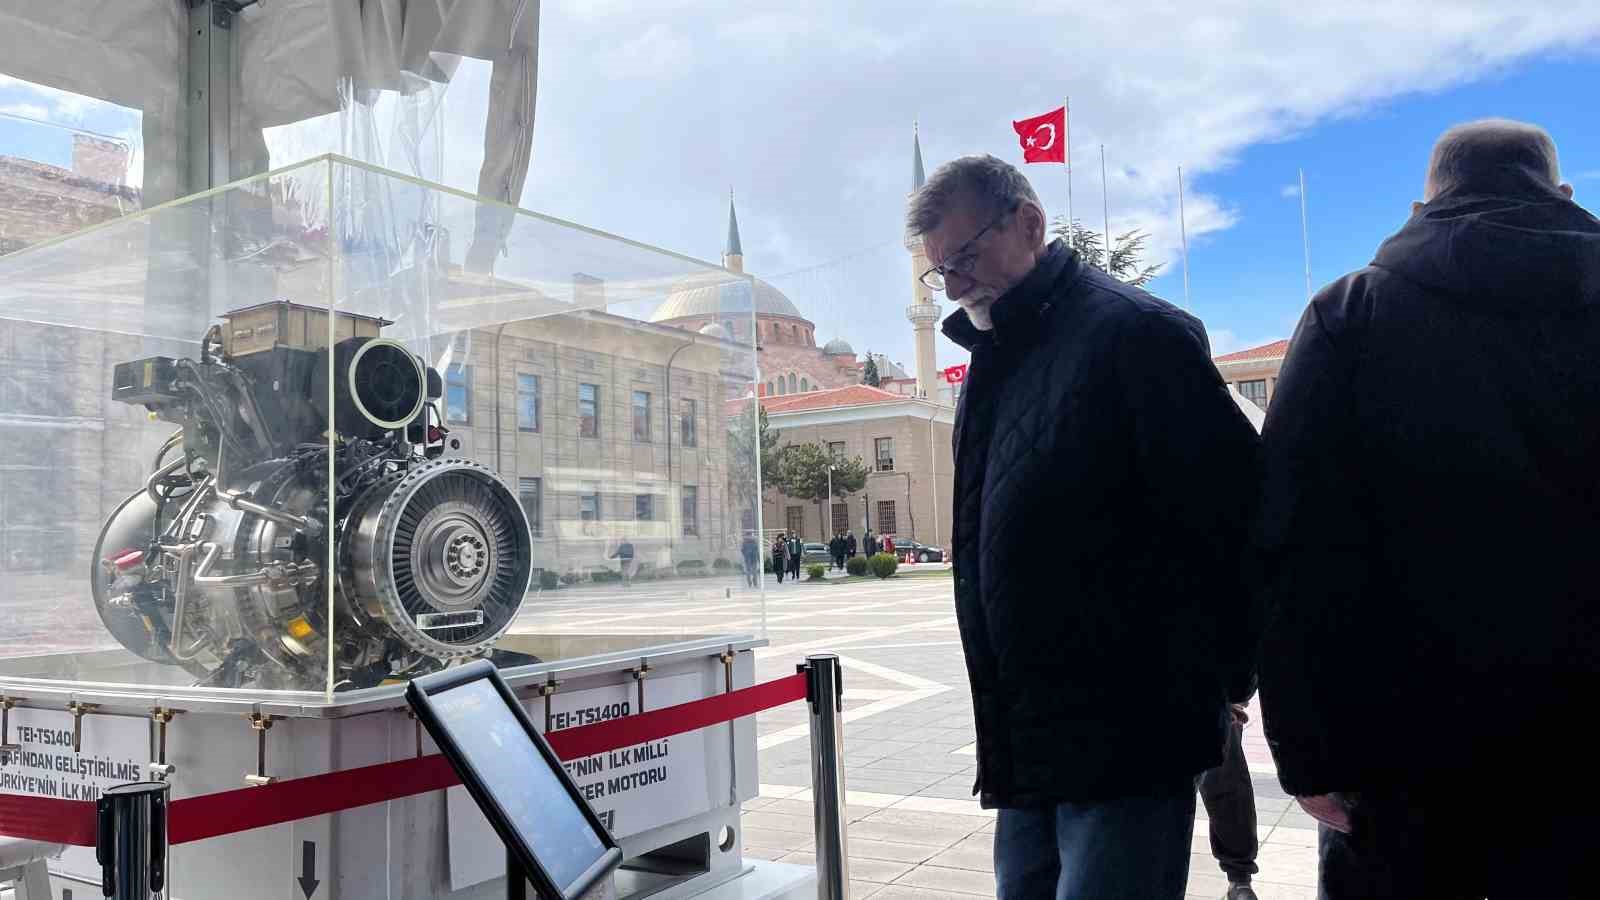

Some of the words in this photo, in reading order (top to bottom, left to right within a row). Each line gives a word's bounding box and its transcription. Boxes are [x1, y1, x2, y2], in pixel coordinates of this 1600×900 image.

[550, 701, 630, 730] TEI-TS1400
[609, 750, 630, 769] İLK
[61, 777, 79, 800] İLK
[608, 766, 667, 796] MOTORU
